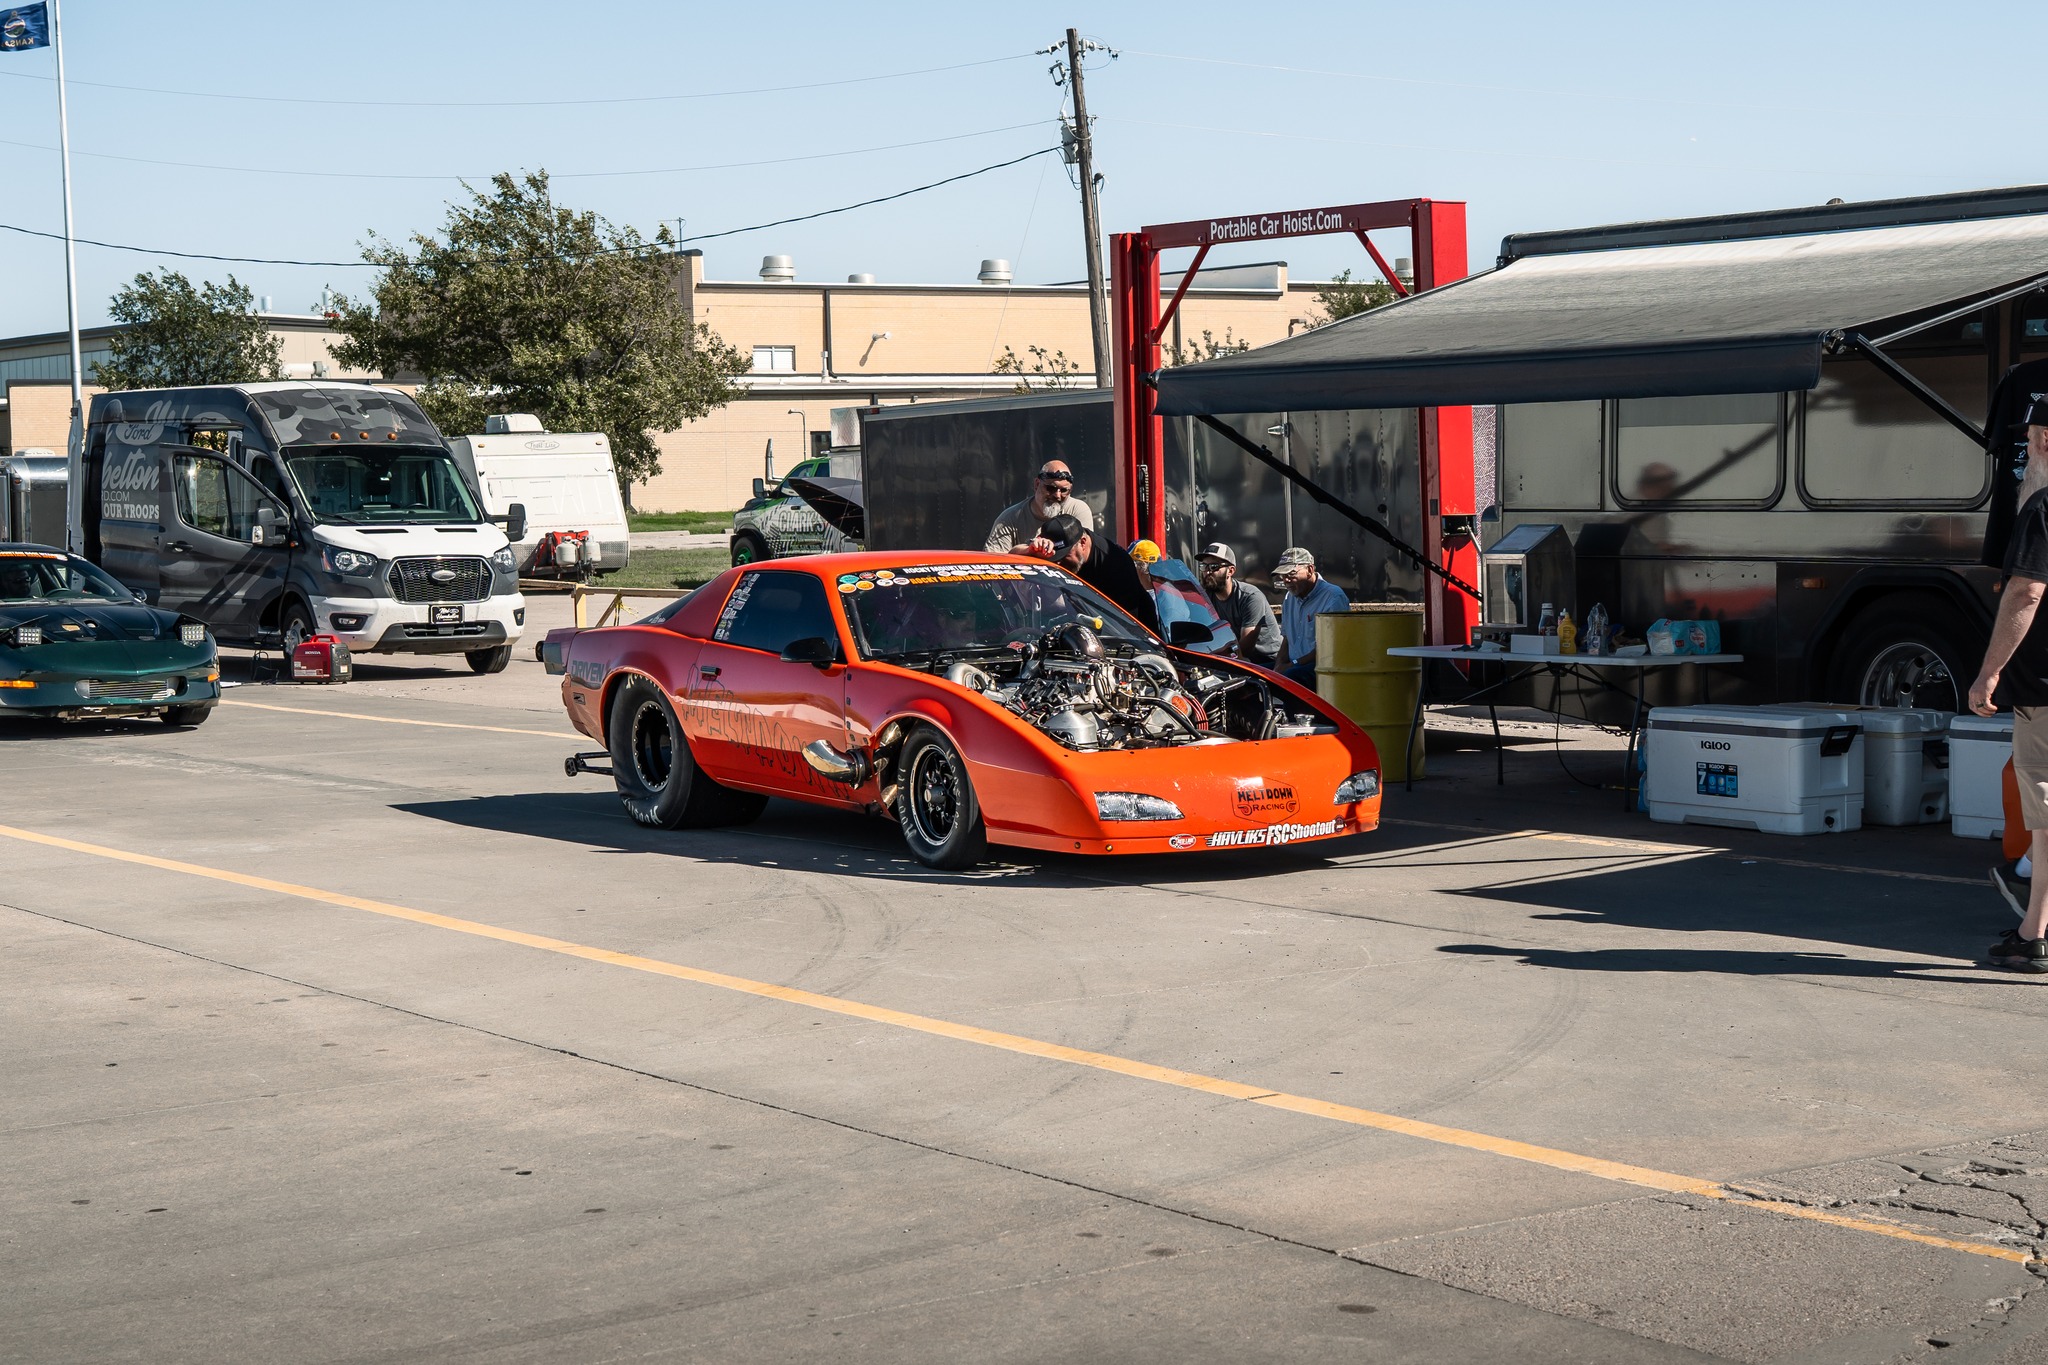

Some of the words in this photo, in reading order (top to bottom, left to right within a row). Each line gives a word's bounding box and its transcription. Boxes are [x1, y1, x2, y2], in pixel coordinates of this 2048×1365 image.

[1210, 217, 1257, 241] Portable
[1260, 216, 1280, 236] Car
[1282, 210, 1343, 234] Hoist.Com
[101, 490, 130, 502] D.COM
[103, 503, 123, 519] OUR
[123, 503, 160, 520] TROOPS
[571, 660, 605, 682] DRIVEN
[1700, 740, 1731, 751] IGLOO
[1237, 787, 1293, 803] MELTDOWN
[1252, 803, 1285, 812] RACING
[1211, 828, 1268, 847] HAVLIKS
